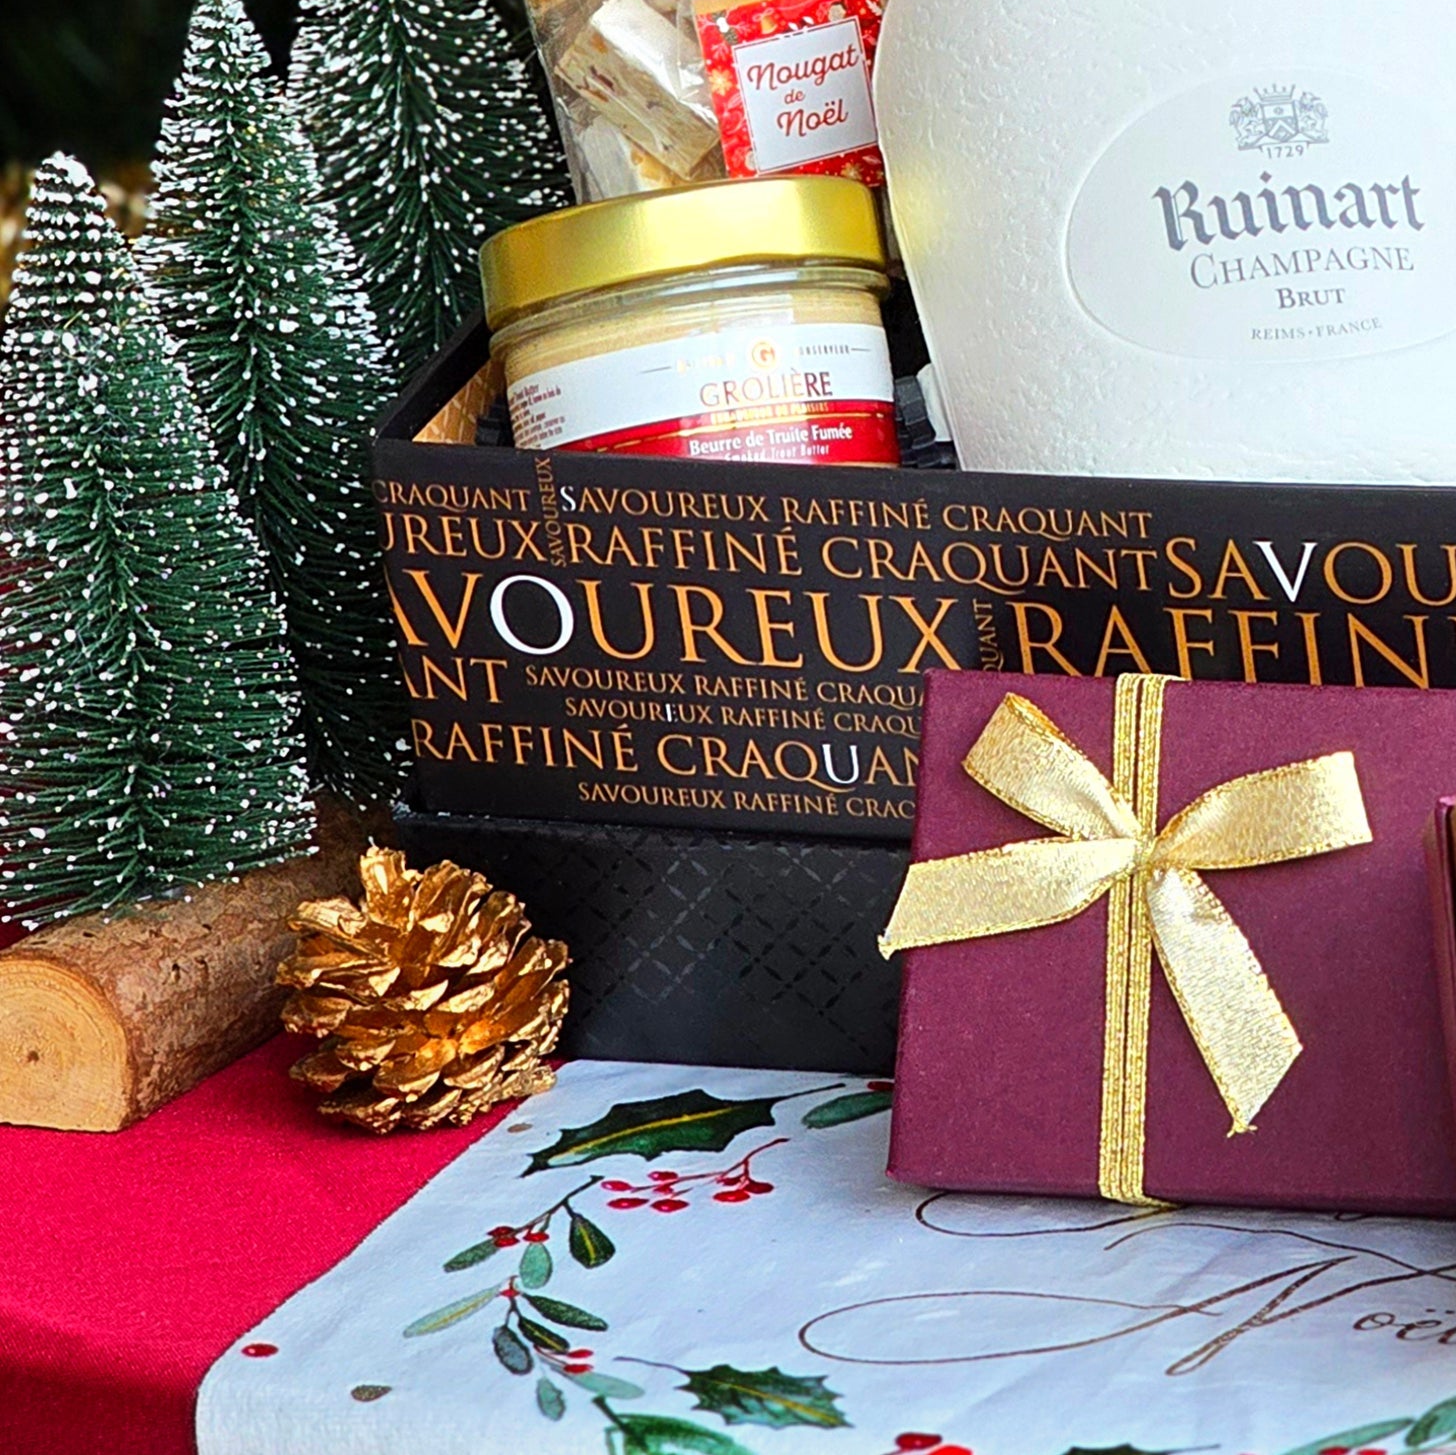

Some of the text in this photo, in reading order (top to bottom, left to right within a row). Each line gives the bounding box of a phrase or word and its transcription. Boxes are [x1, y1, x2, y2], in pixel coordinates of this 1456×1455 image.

[746, 44, 861, 91] Nougat
[783, 88, 806, 105] de
[776, 98, 849, 138] Noël
[1265, 145, 1305, 160] 1729
[1151, 170, 1426, 252] Ruinart
[1190, 246, 1415, 290] CHAMPAGNE
[1276, 287, 1347, 310] BRUT
[699, 367, 833, 408] GROLIÈRE
[688, 422, 853, 456] Beurre de Truite Fumée
[371, 479, 1153, 542] CRAQUANT SAVOUREUX RAFFINÉ CRAQUANT
[535, 456, 567, 568] SAVOUREUX
[564, 521, 803, 576] RAFFINÉ
[821, 536, 1158, 595] CRAQUANT
[525, 663, 686, 695] SAVOUREUX
[694, 675, 809, 702] RAFFINÉ
[565, 697, 714, 726] SAVOUREUX
[721, 707, 827, 731] RAFFINÉ
[410, 717, 639, 773] RAFFINÉ
[578, 781, 728, 810] SAVOUREUX
[733, 792, 840, 817] RAFFINÉ
